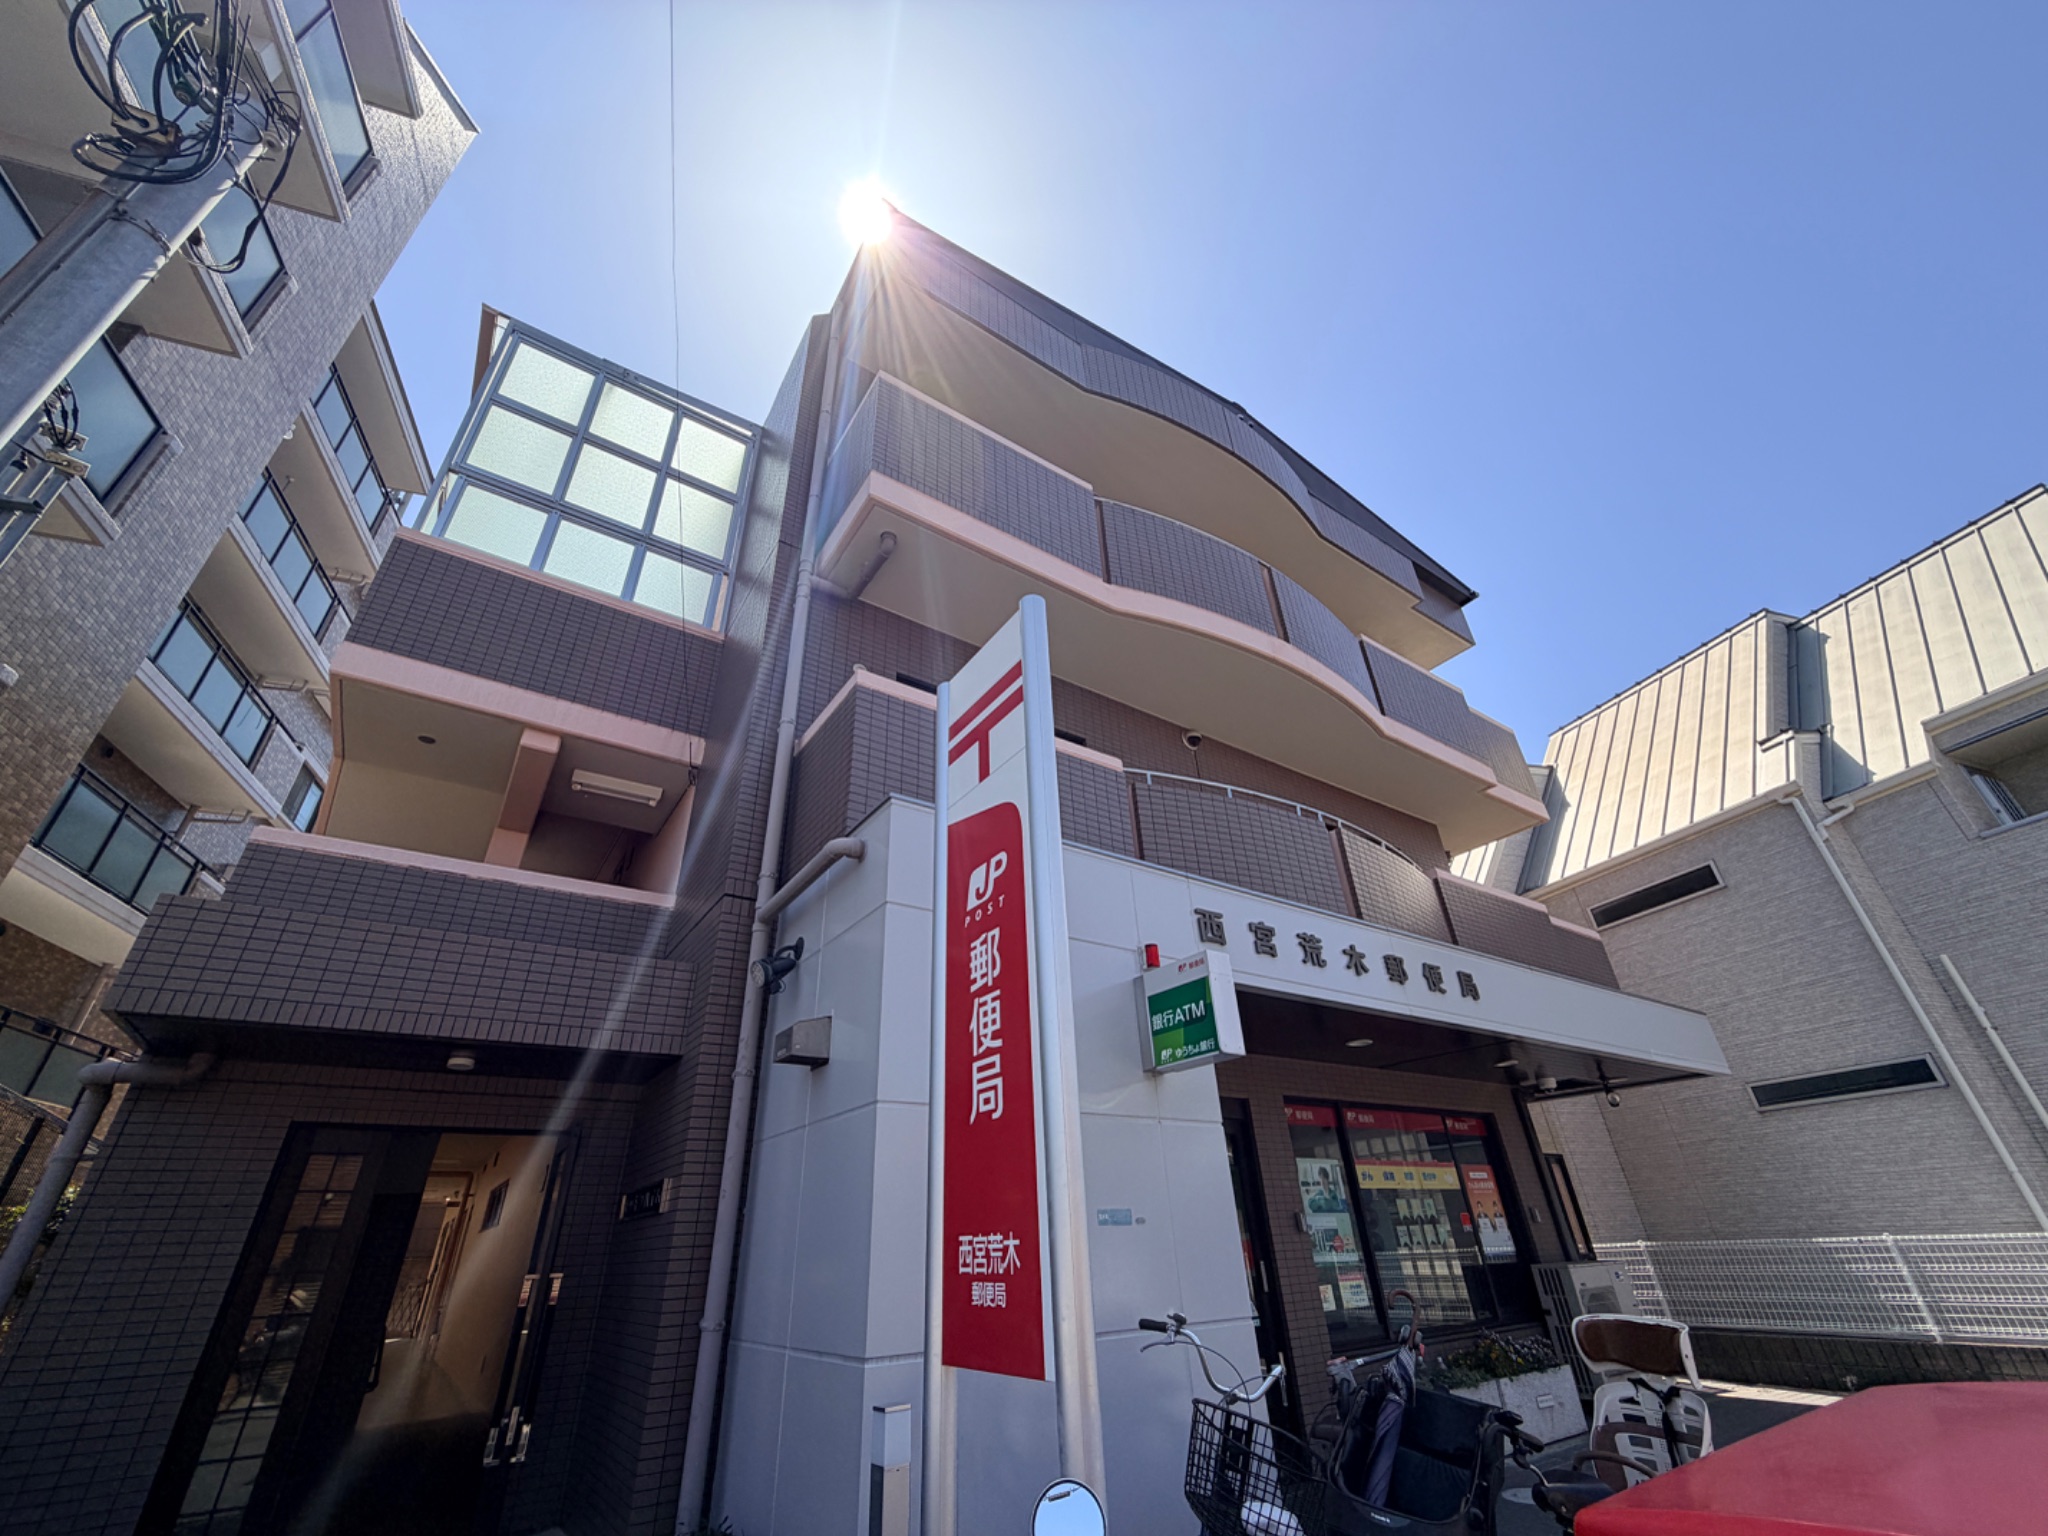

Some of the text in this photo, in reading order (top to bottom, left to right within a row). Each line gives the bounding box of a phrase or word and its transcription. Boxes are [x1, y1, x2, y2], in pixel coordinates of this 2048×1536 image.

[964, 895, 1006, 928] POST
[1195, 908, 1481, 1001] 西宮荒木郵便局
[969, 927, 1004, 1125] 郵便局
[1151, 999, 1206, 1032] 銀行ATM
[958, 1231, 1021, 1275] 西宮荒木
[971, 1281, 1007, 1308] 郵便局
